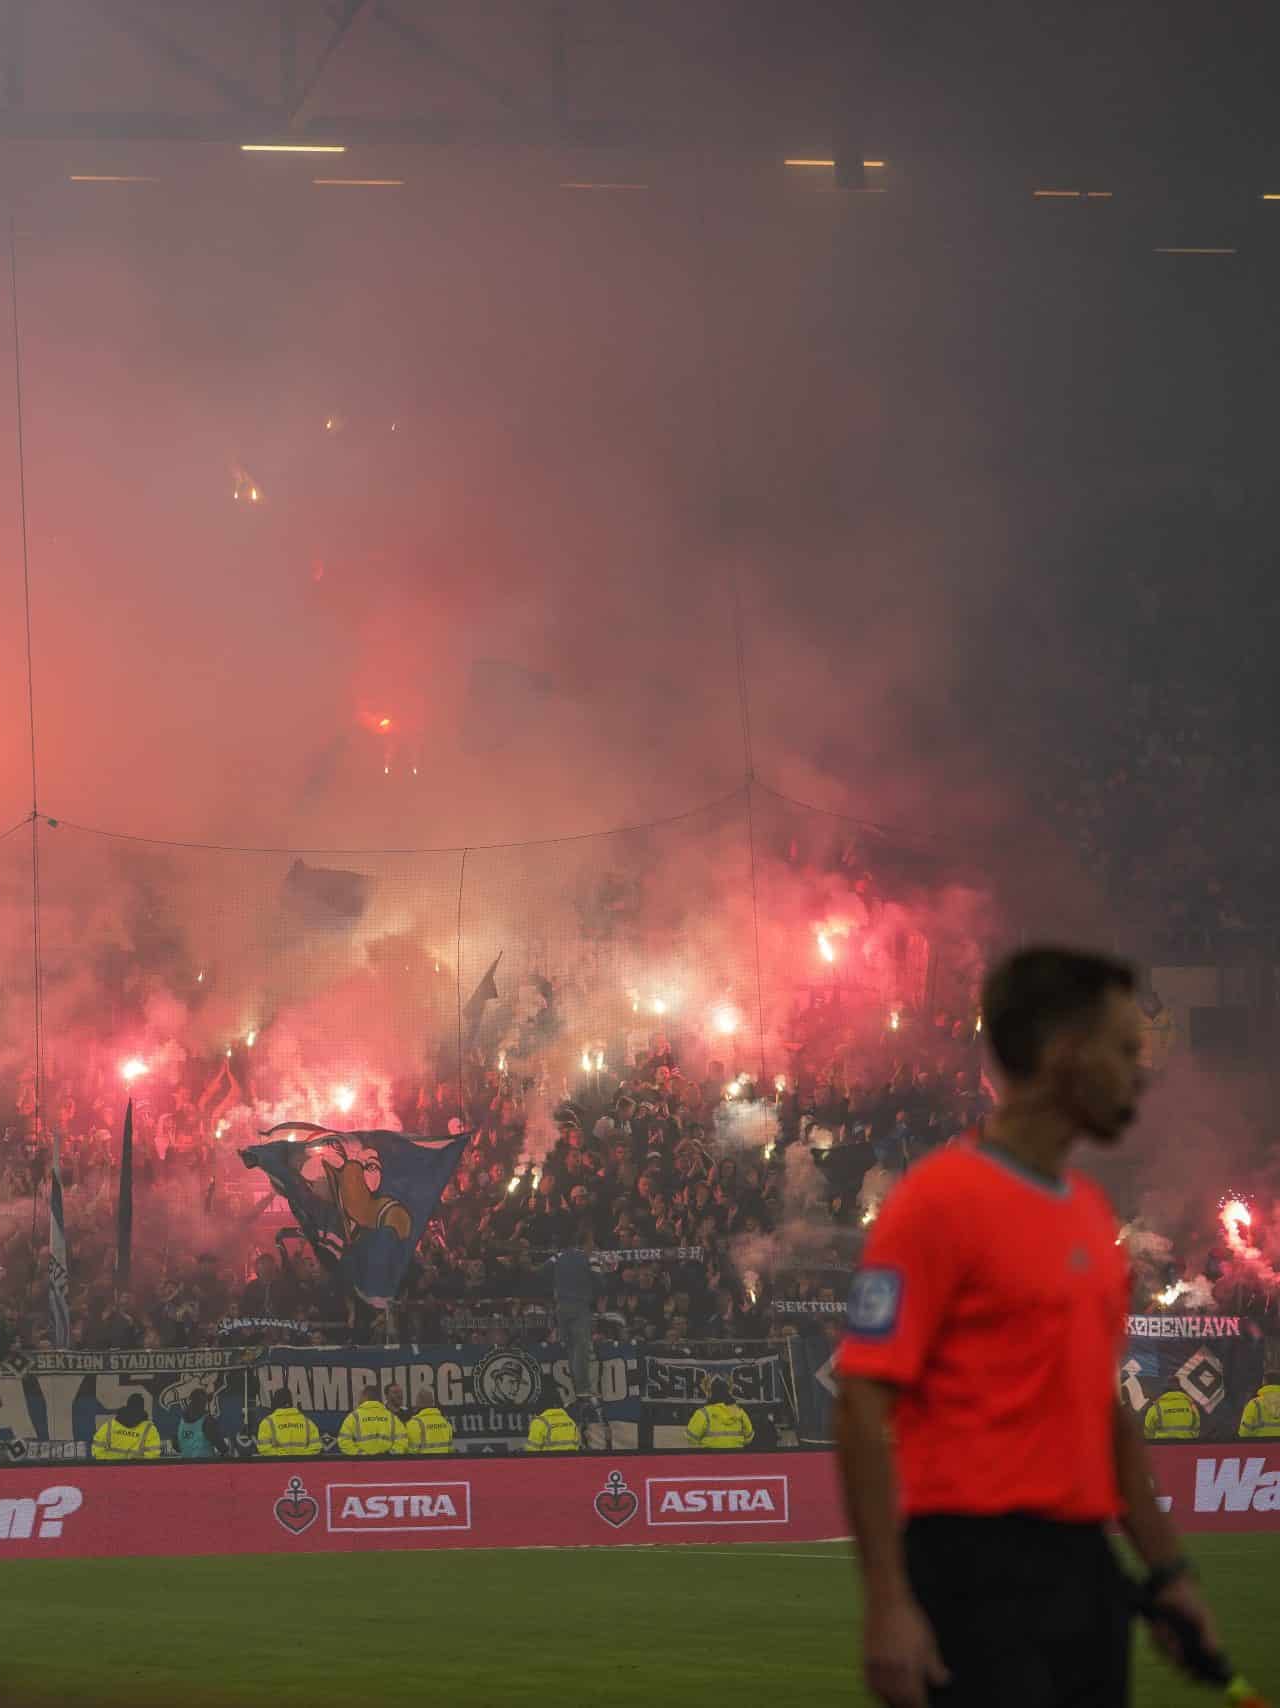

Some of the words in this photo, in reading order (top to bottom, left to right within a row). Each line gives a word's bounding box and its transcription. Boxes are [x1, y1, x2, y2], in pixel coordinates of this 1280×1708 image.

[37, 1352, 104, 1370] SEKTION
[341, 1495, 457, 1519] ASTRA
[660, 1489, 776, 1513] ASTRA
